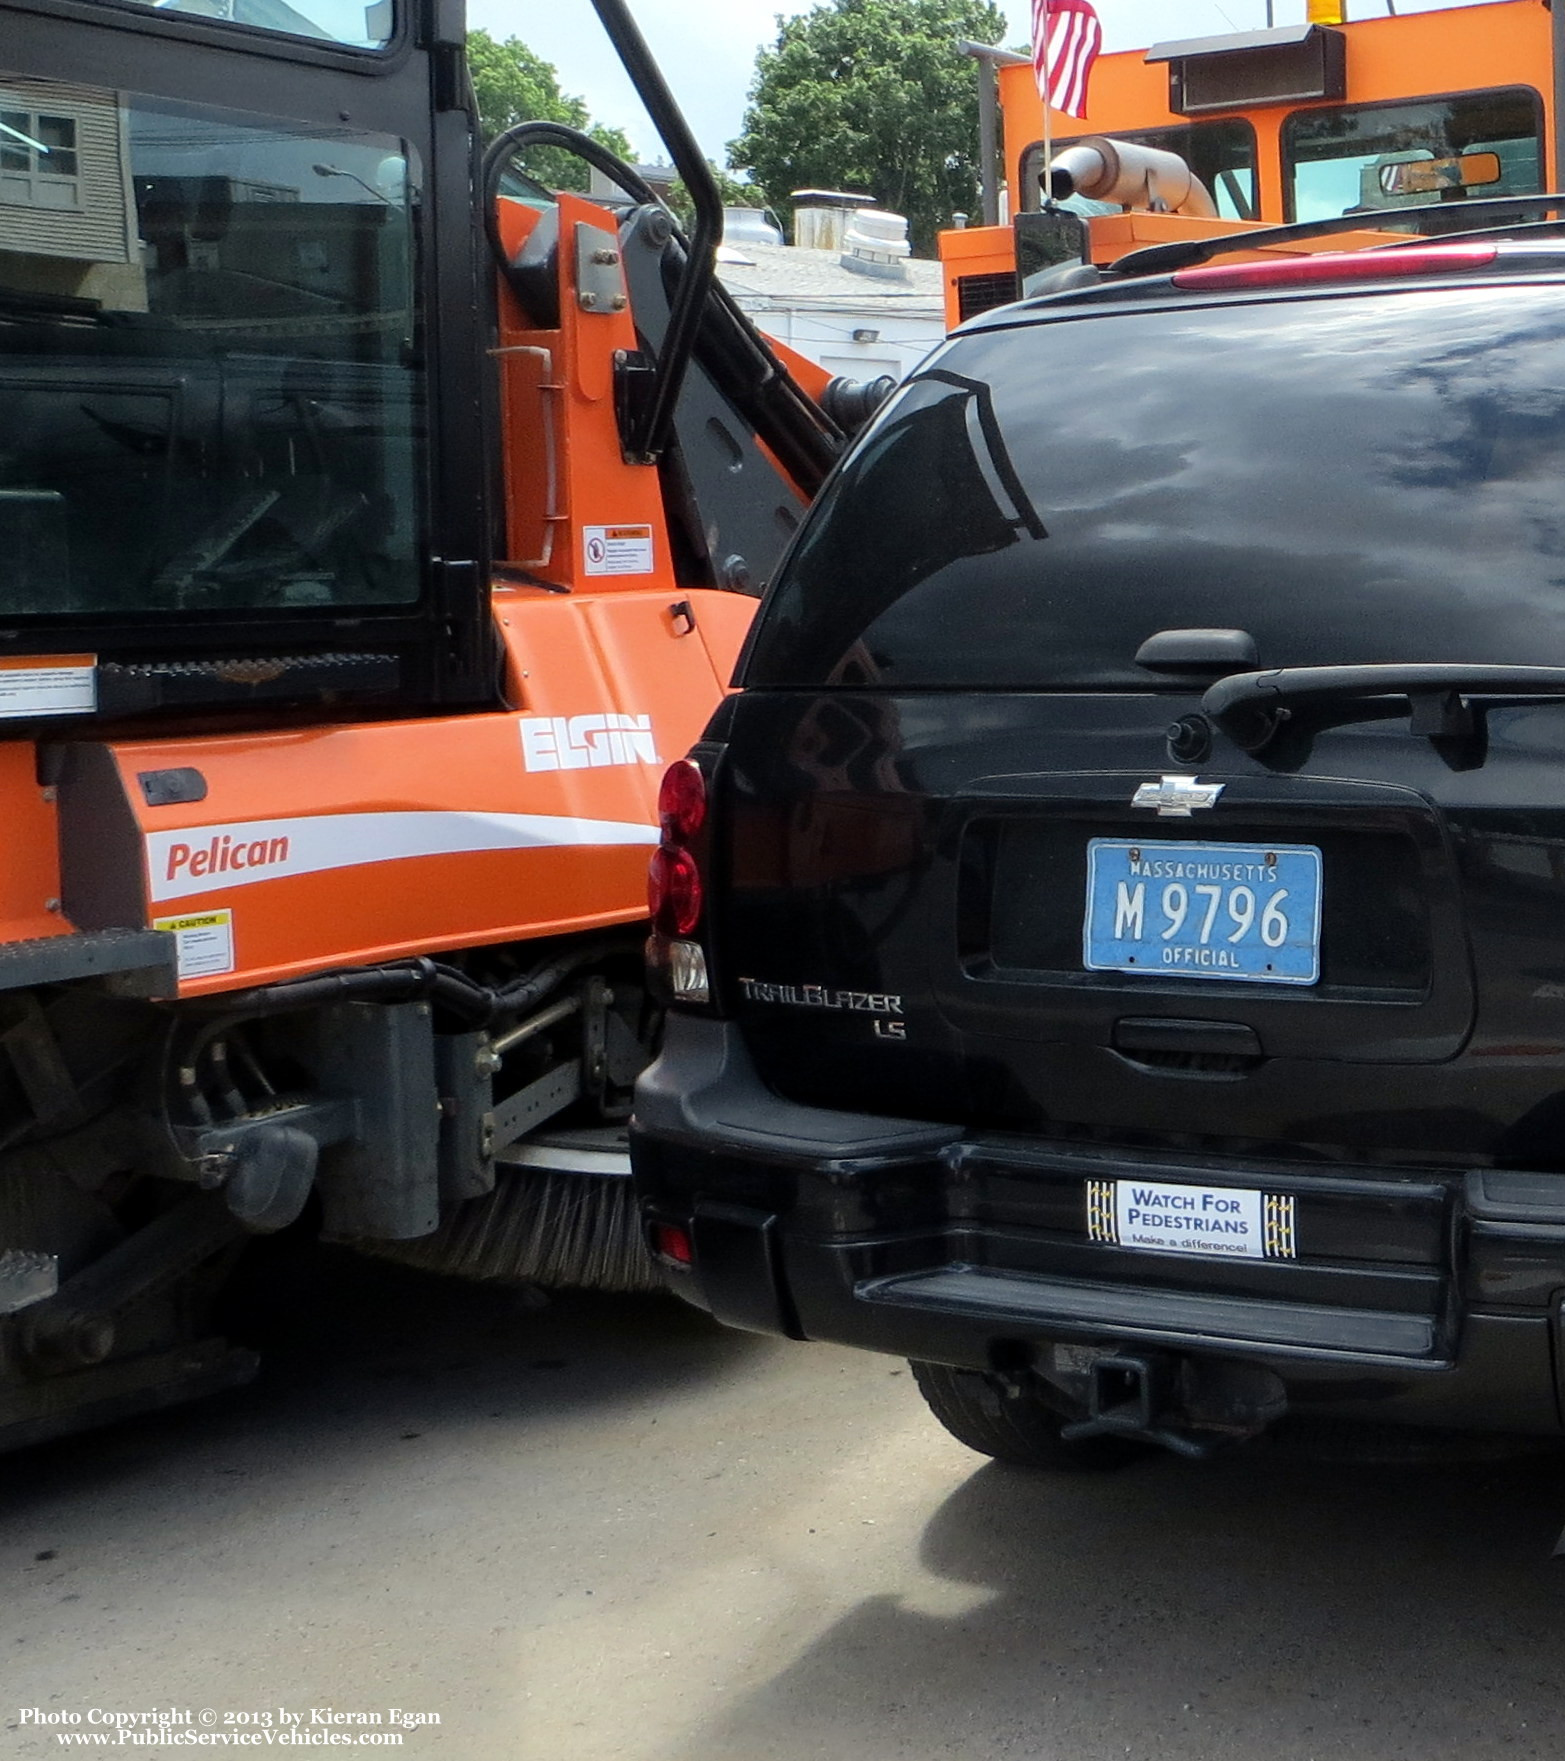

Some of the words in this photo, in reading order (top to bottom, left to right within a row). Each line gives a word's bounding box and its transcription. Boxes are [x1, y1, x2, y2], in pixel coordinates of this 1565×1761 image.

[519, 713, 657, 772] ELGIN
[166, 834, 289, 881] Pelican
[1130, 860, 1277, 883] MASSACHUSETTS
[179, 915, 217, 928] CAUTION
[1162, 948, 1240, 968] OFFICIAL
[873, 1019, 906, 1040] LS
[1128, 1208, 1249, 1235] PEDESTRIANS
[1132, 1233, 1165, 1246] Make
[1169, 1239, 1178, 1247] a
[1181, 1237, 1248, 1253] difference!
